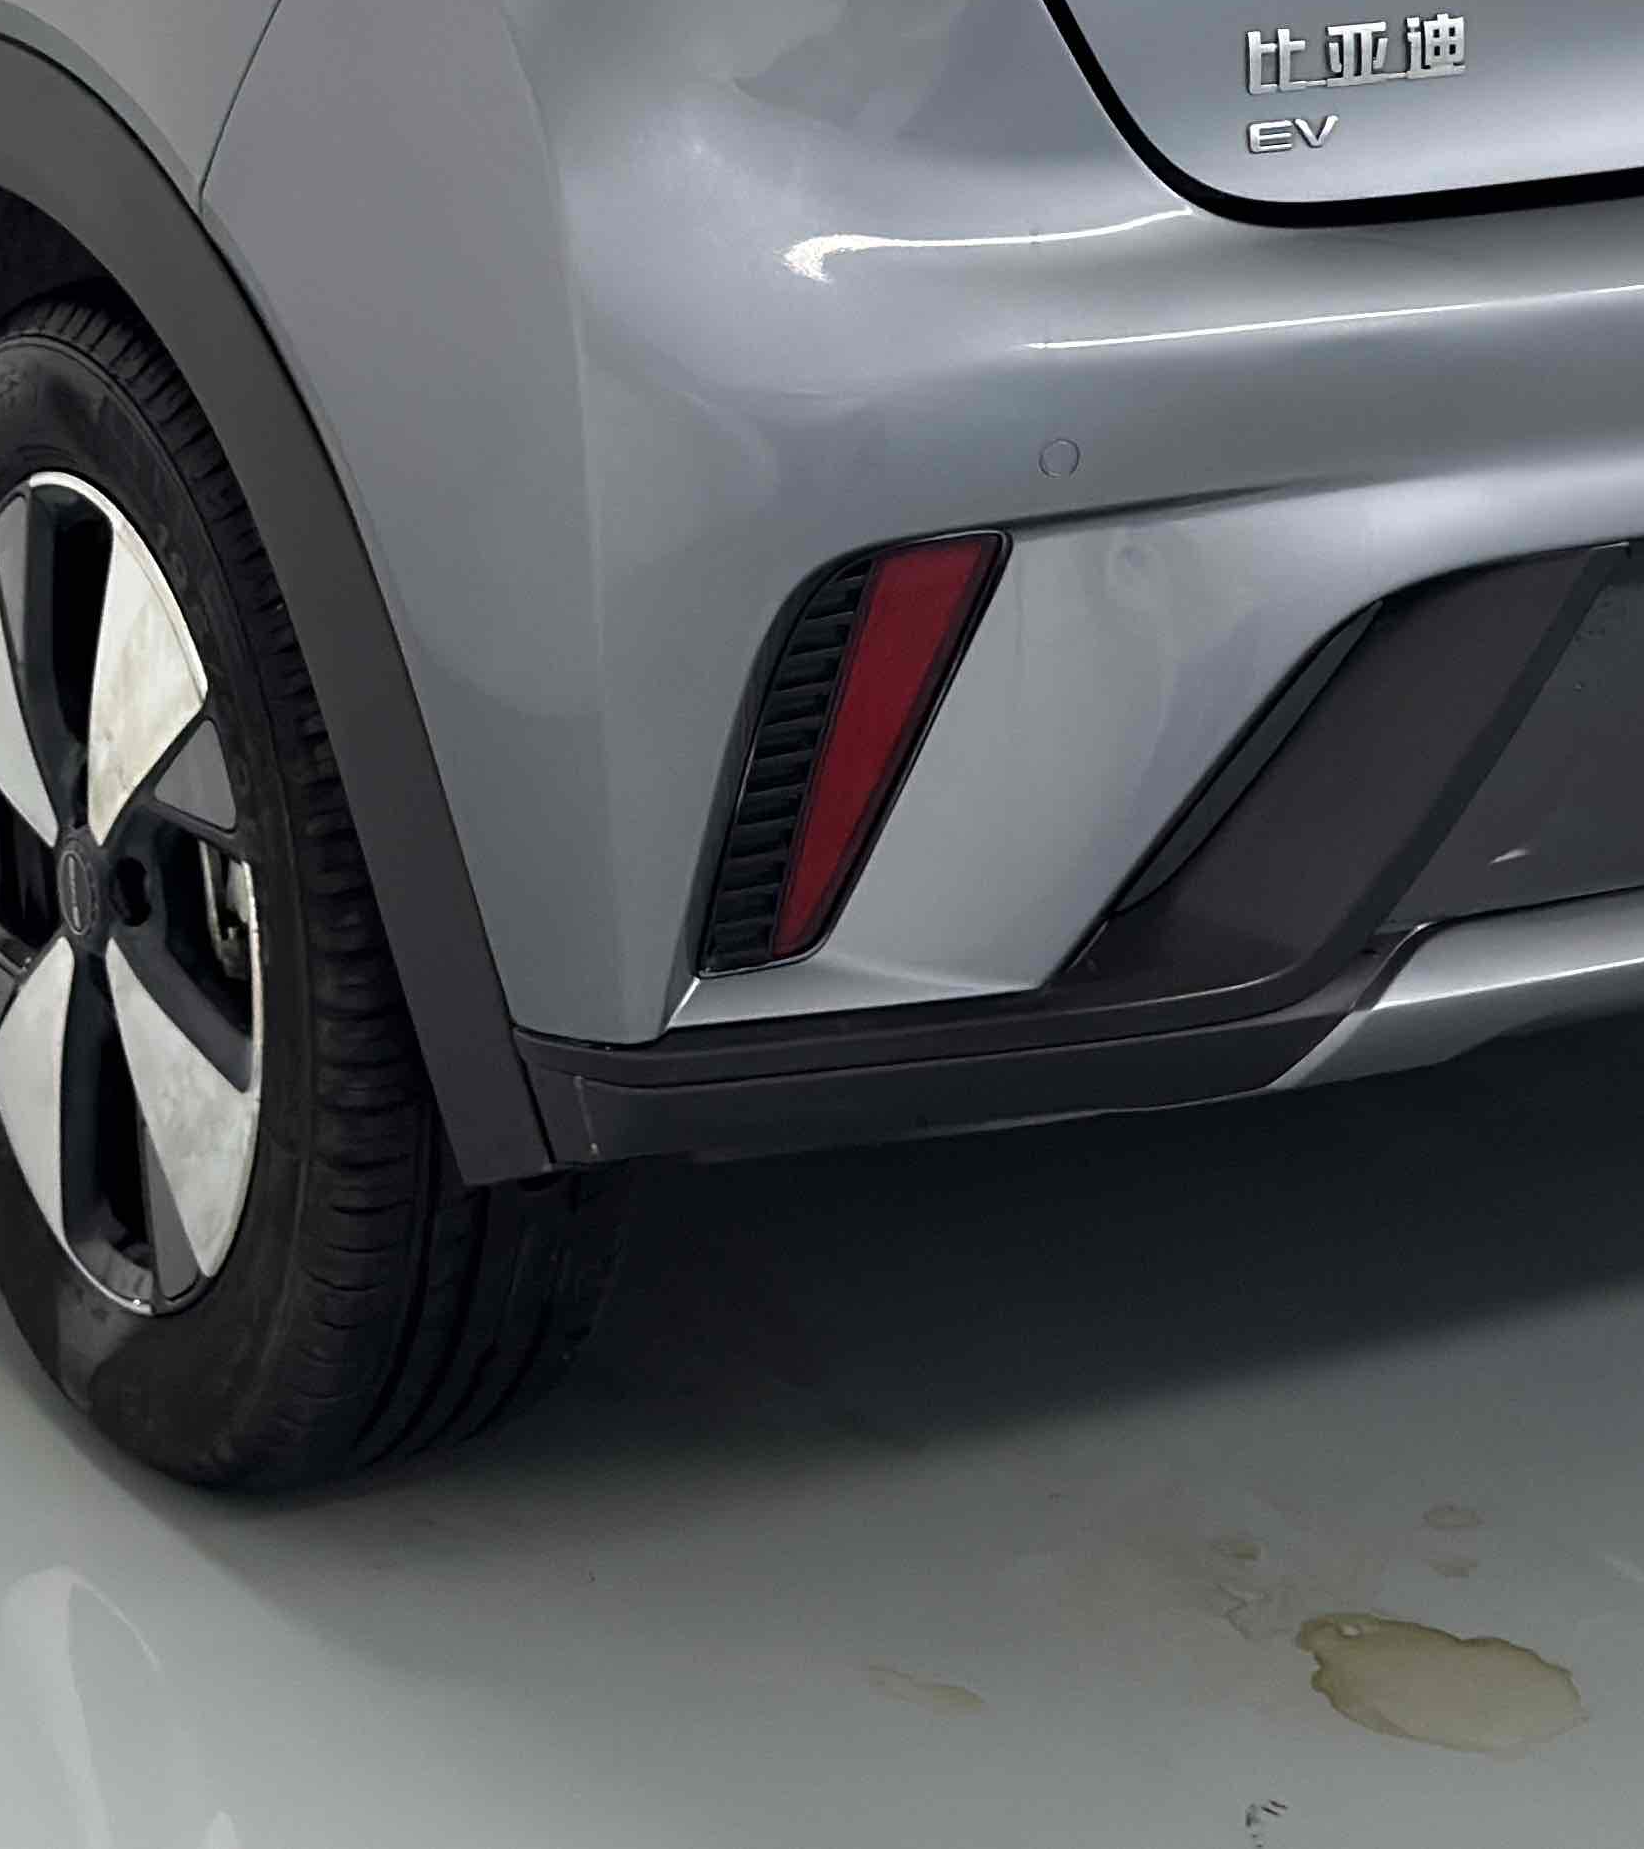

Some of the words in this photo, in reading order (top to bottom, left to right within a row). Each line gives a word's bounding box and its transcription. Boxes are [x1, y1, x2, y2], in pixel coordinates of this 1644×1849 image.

[1247, 12, 1466, 95] 比亚迪
[1248, 114, 1339, 154] EV
